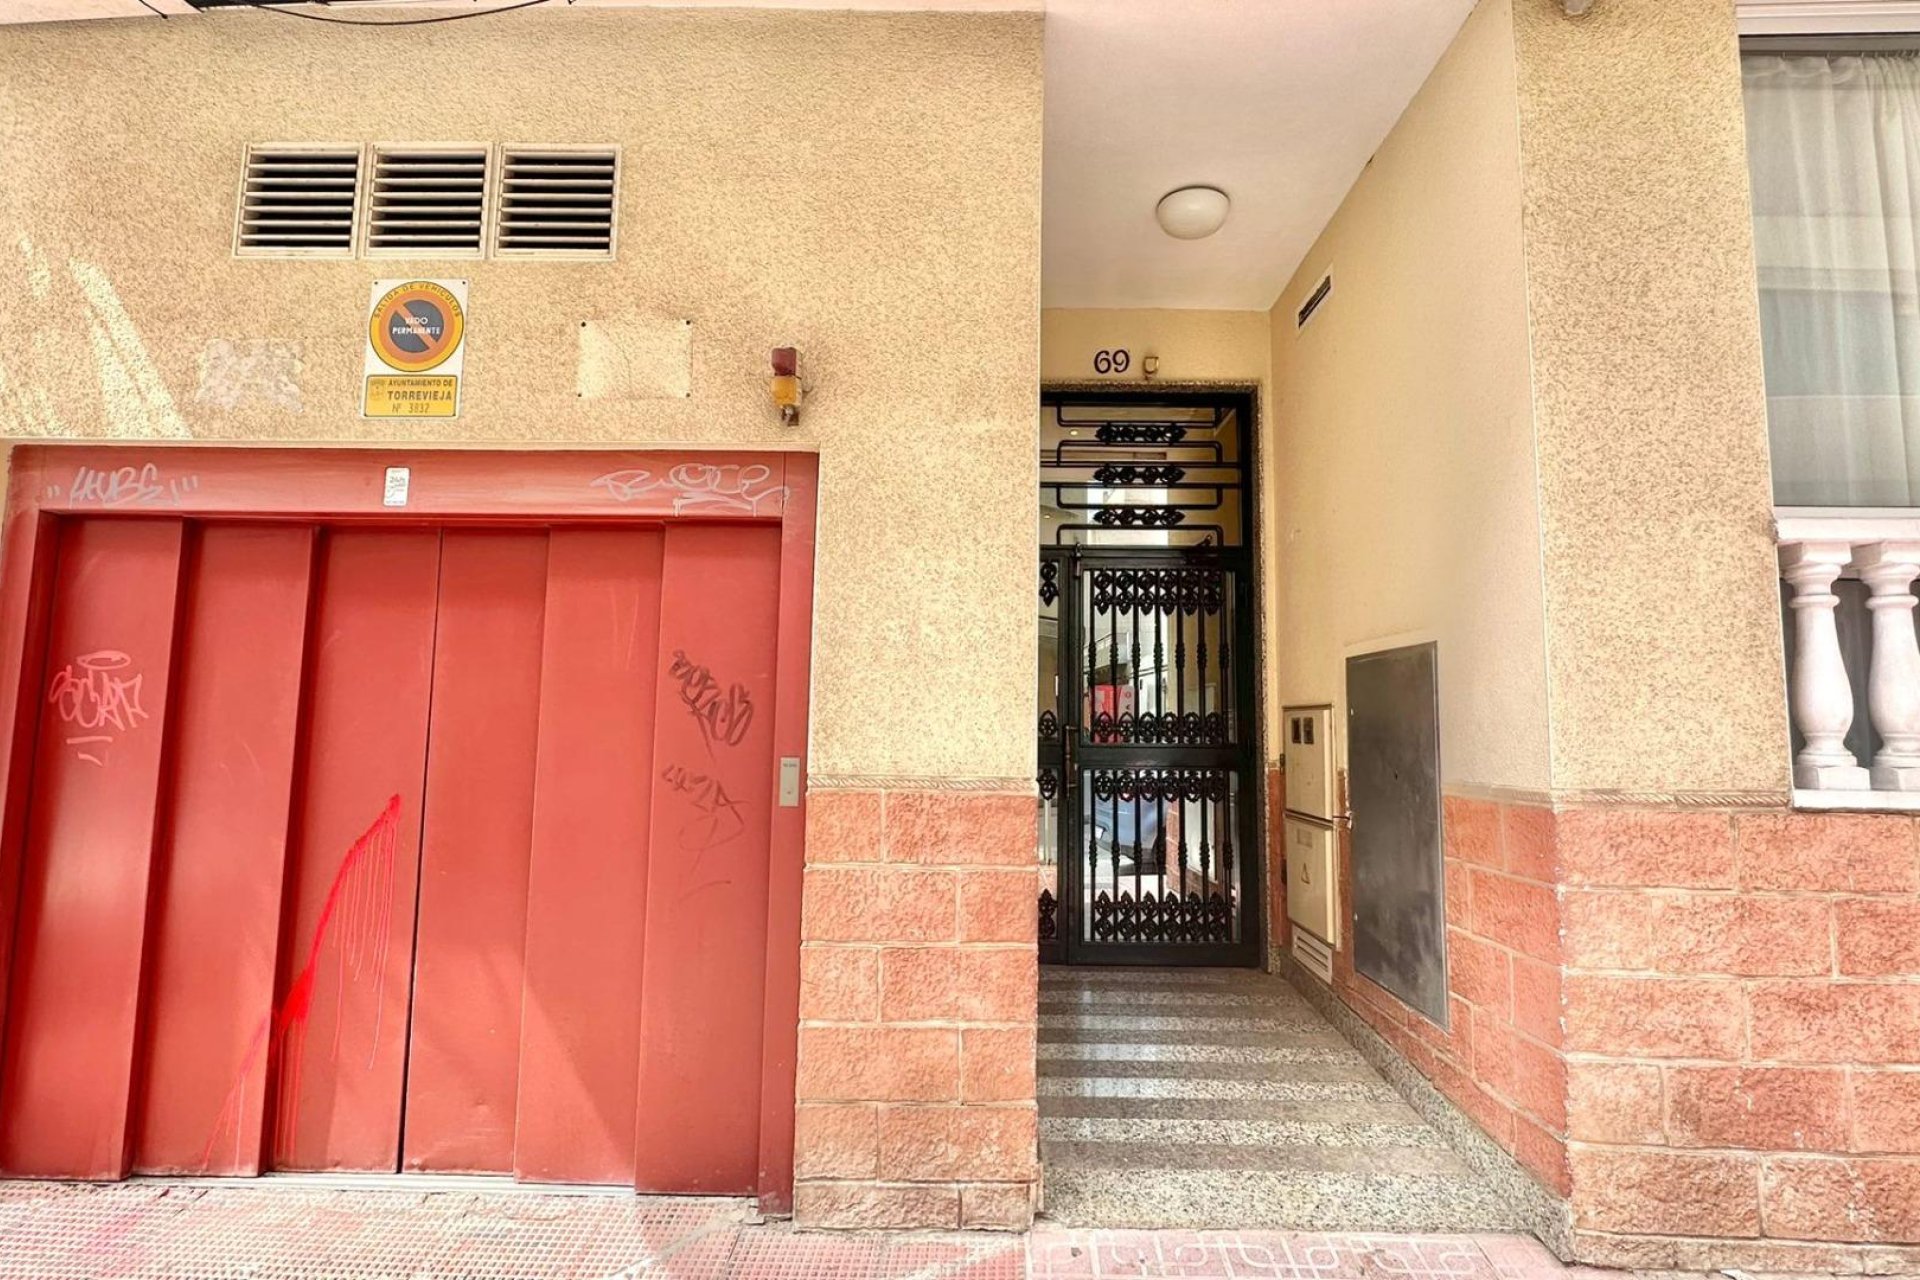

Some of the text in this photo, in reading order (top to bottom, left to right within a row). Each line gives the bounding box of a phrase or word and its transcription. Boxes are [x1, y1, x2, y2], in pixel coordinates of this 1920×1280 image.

[374, 290, 400, 318] SALIDA
[402, 284, 415, 292] DE
[1094, 349, 1130, 374] 69
[388, 379, 453, 387] AYUNTAMIENTO DE
[387, 391, 452, 400] TORREVIEJA
